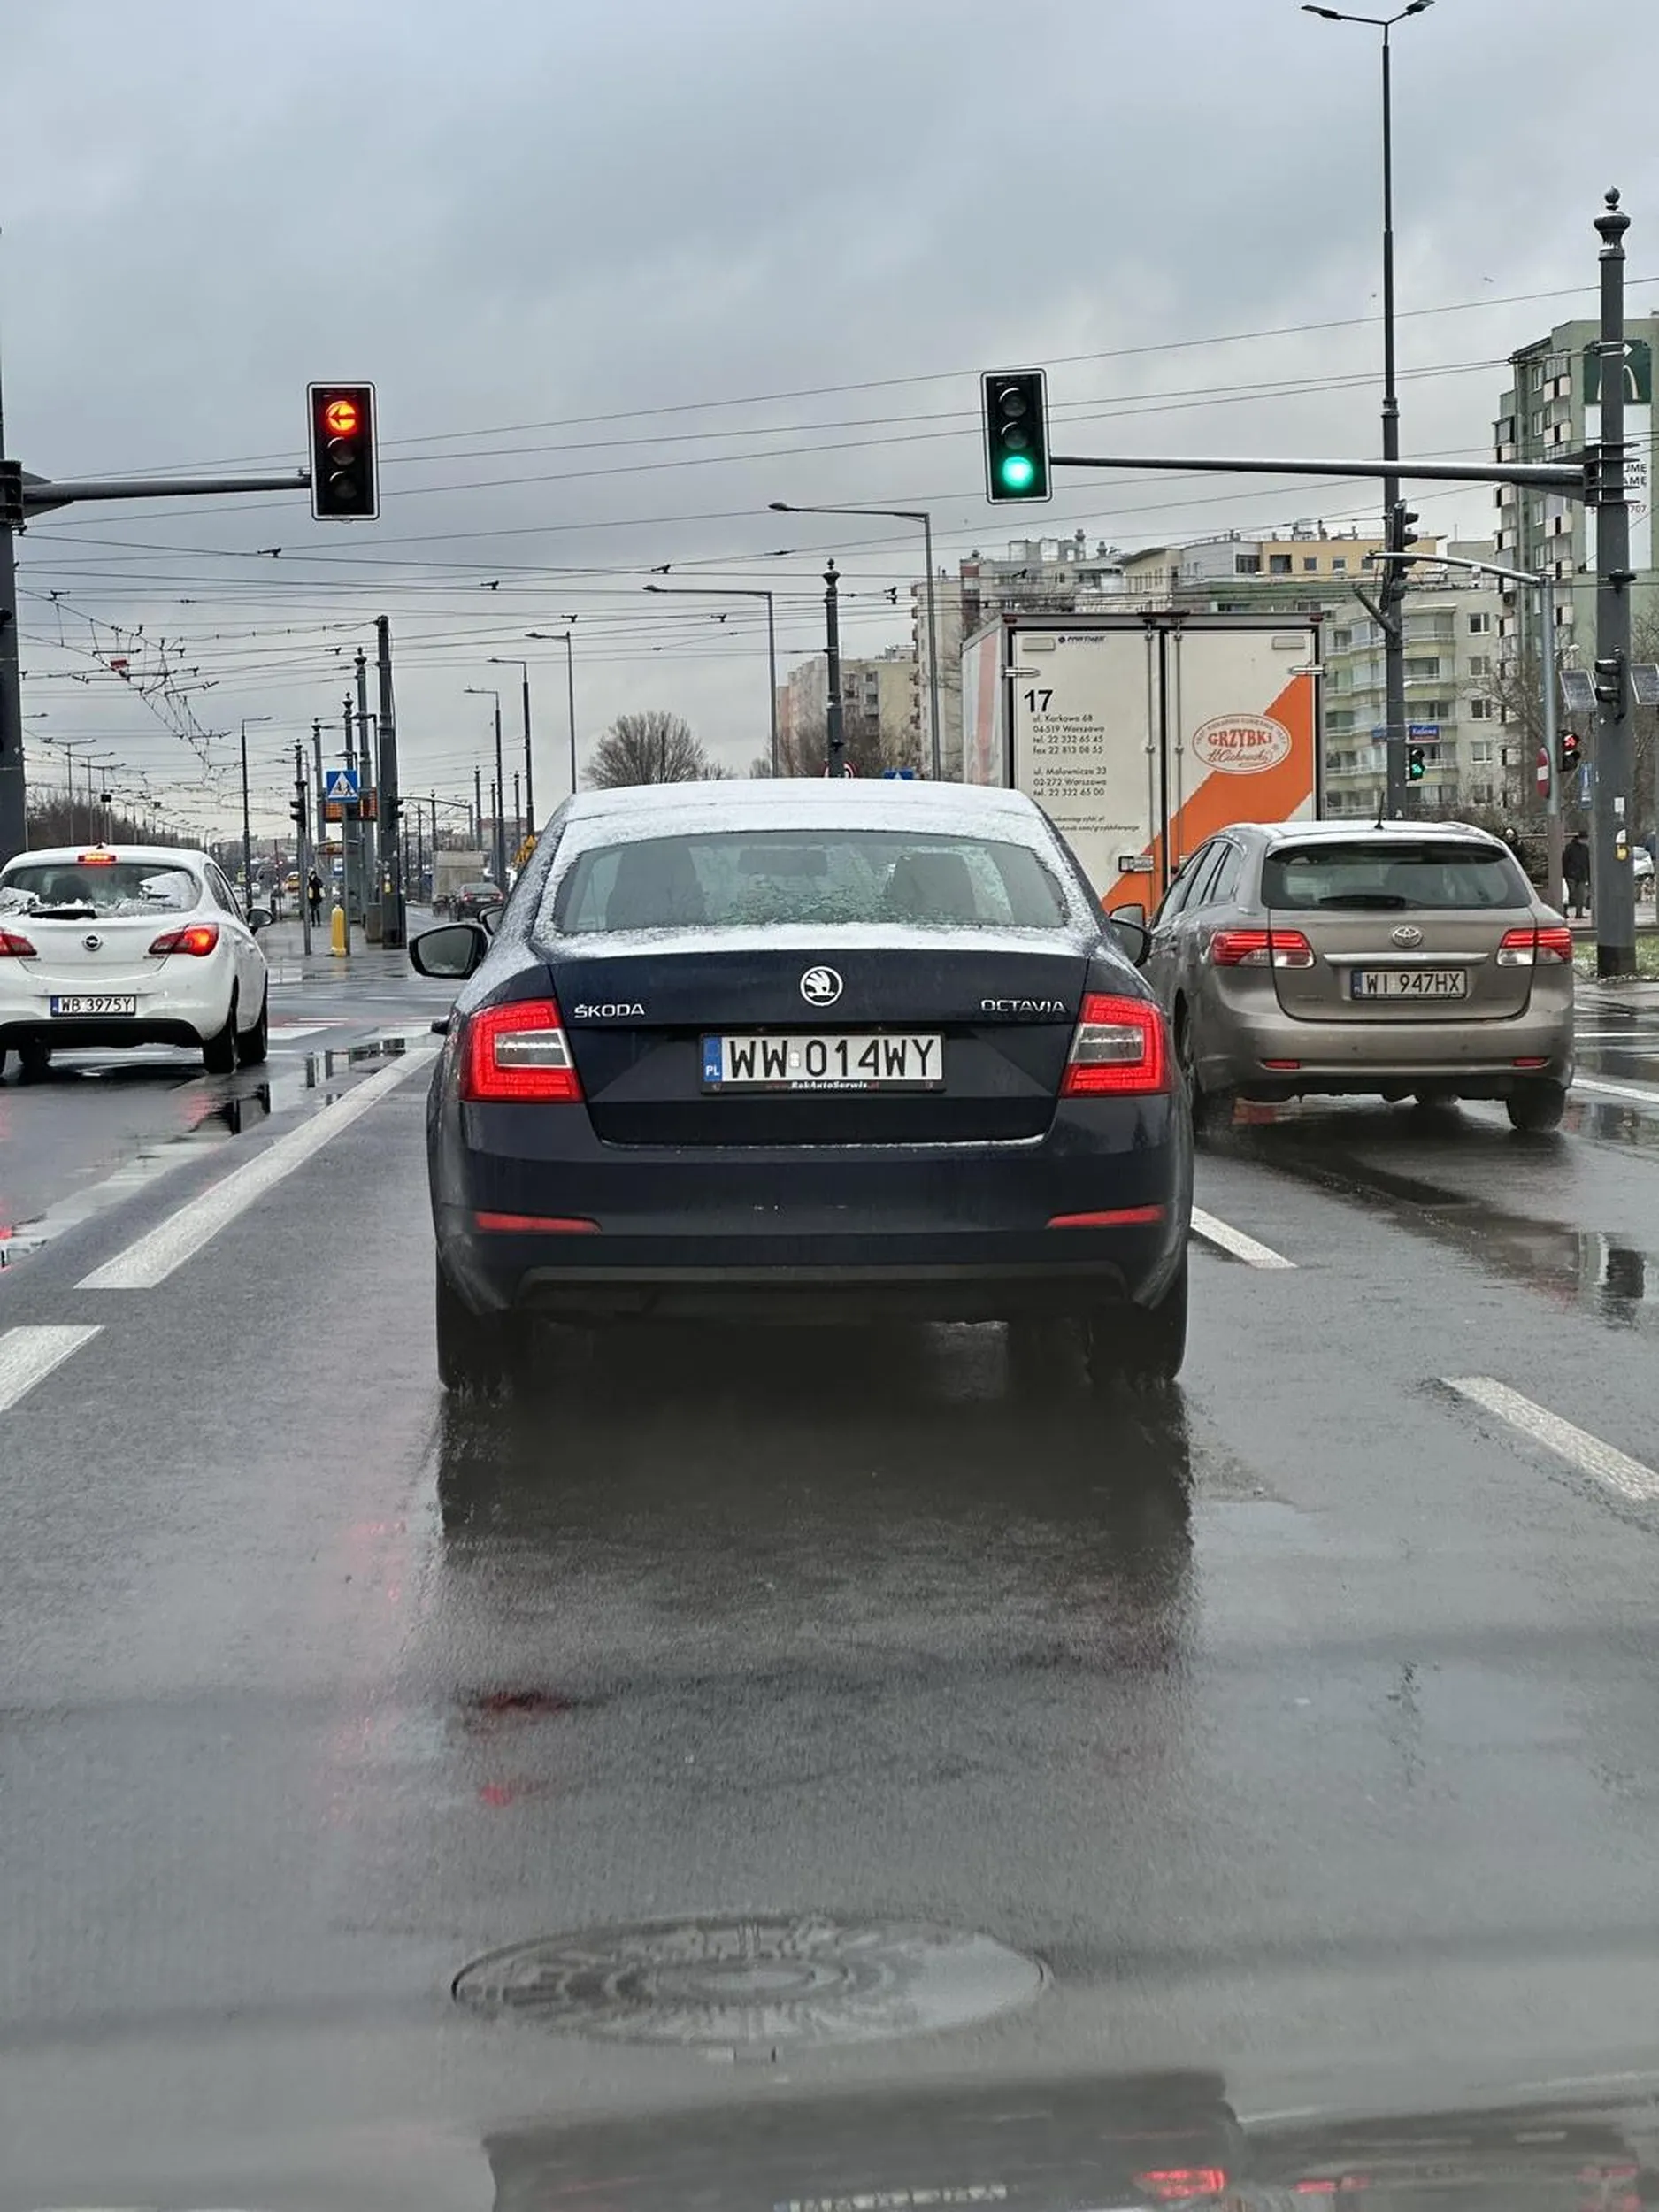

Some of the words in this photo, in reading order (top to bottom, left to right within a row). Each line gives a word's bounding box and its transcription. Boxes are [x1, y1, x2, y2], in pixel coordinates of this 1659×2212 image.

[1024, 689, 1053, 712] 17
[1366, 973, 1388, 993] WI
[1400, 973, 1460, 993] 947HX
[61, 997, 81, 1012] WB
[86, 997, 131, 1012] 3975Y
[573, 1003, 645, 1018] ŠKODA
[980, 999, 1067, 1014] OCTAVIA
[729, 1039, 787, 1078] WW
[806, 1039, 934, 1078] 014WY
[705, 1065, 720, 1077] PL
